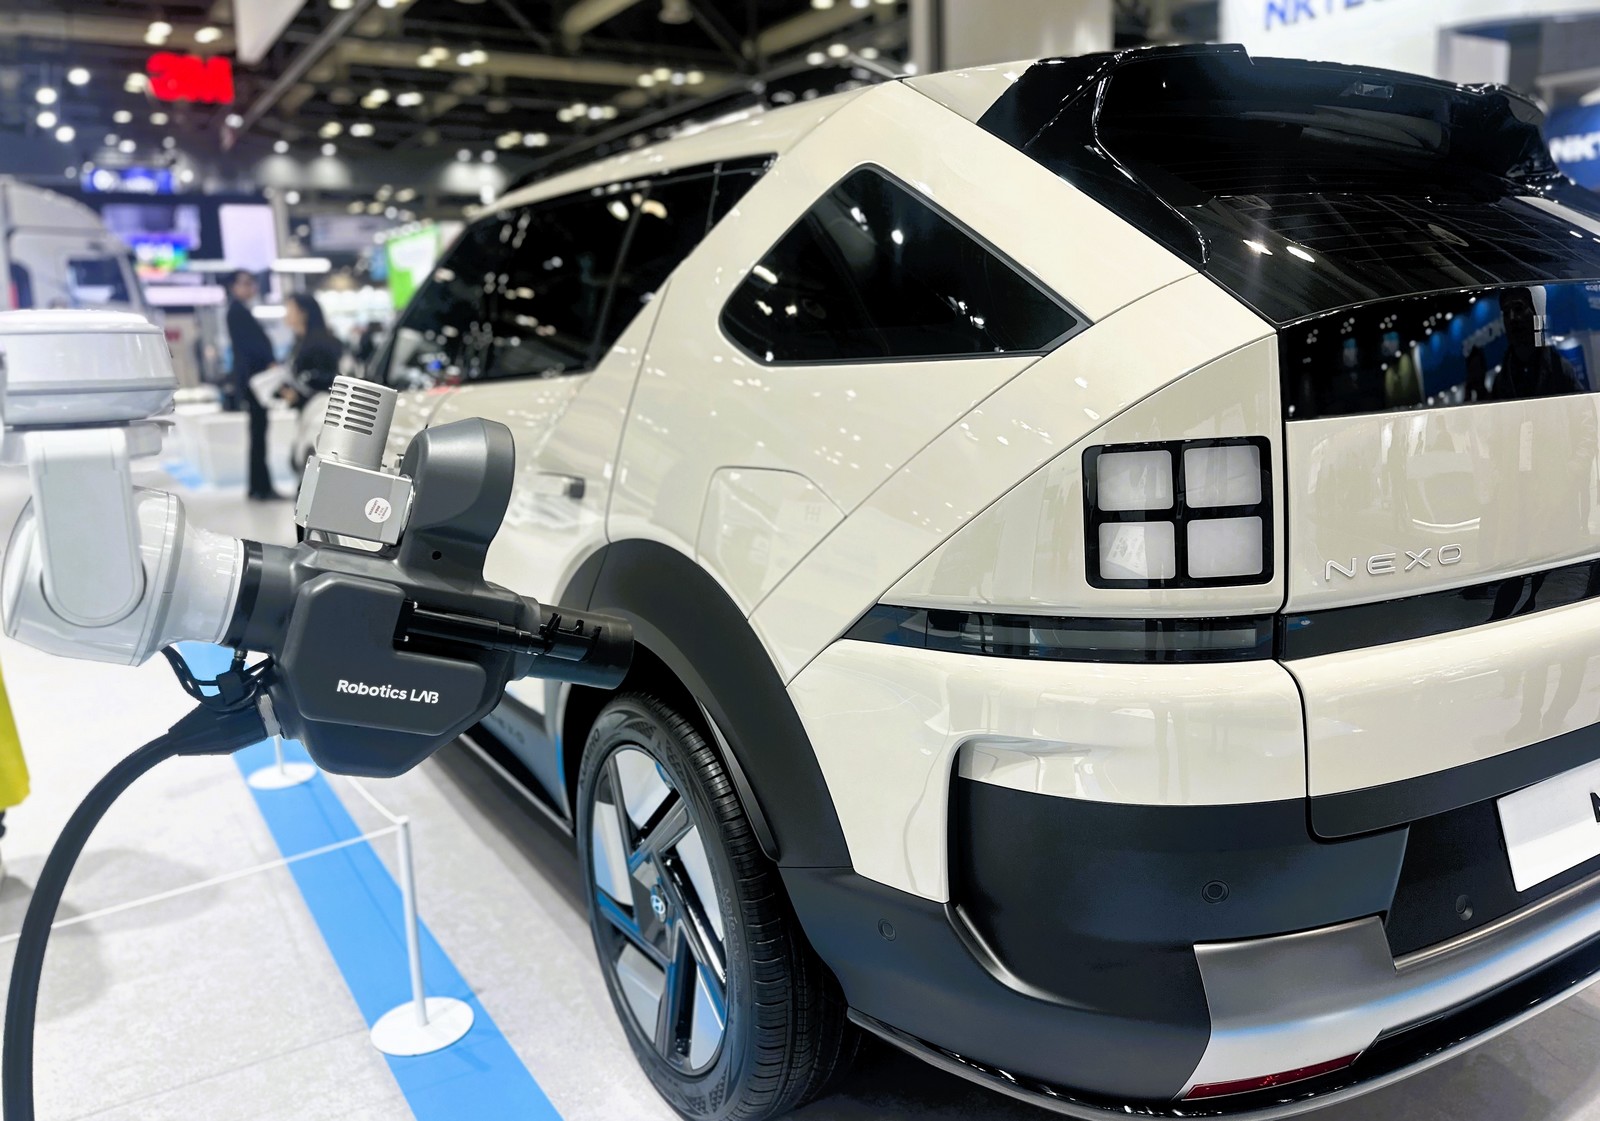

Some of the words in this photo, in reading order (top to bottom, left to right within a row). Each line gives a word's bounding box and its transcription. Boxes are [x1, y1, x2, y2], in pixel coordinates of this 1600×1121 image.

[146, 51, 235, 105] 3M
[1325, 543, 1462, 581] NEXO
[336, 679, 407, 700] Robotics
[409, 688, 440, 705] LAB
